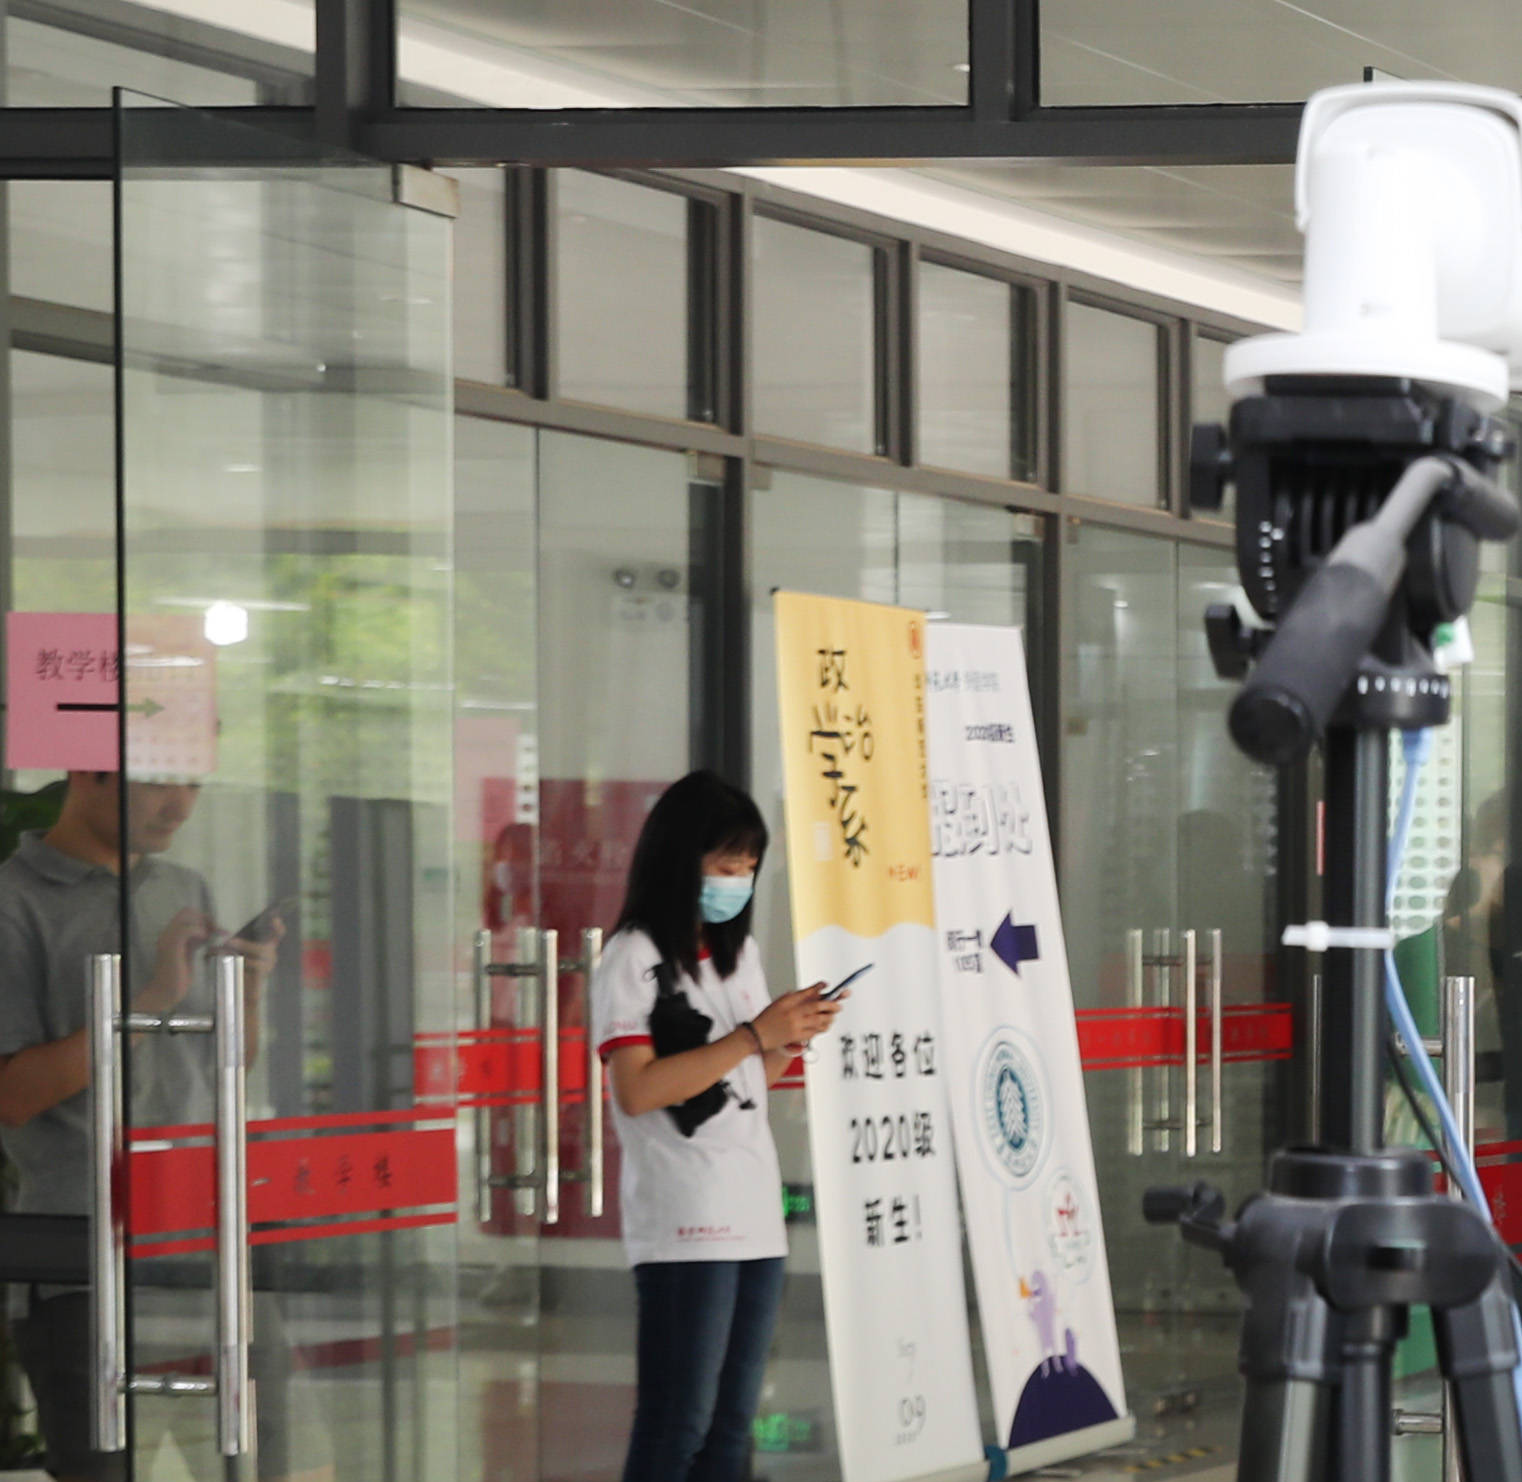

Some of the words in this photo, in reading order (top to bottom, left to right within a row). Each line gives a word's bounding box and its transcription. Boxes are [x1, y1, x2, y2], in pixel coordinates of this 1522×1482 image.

[839, 1031, 937, 1080] 欢迎各位
[849, 1111, 936, 1164] 2020级
